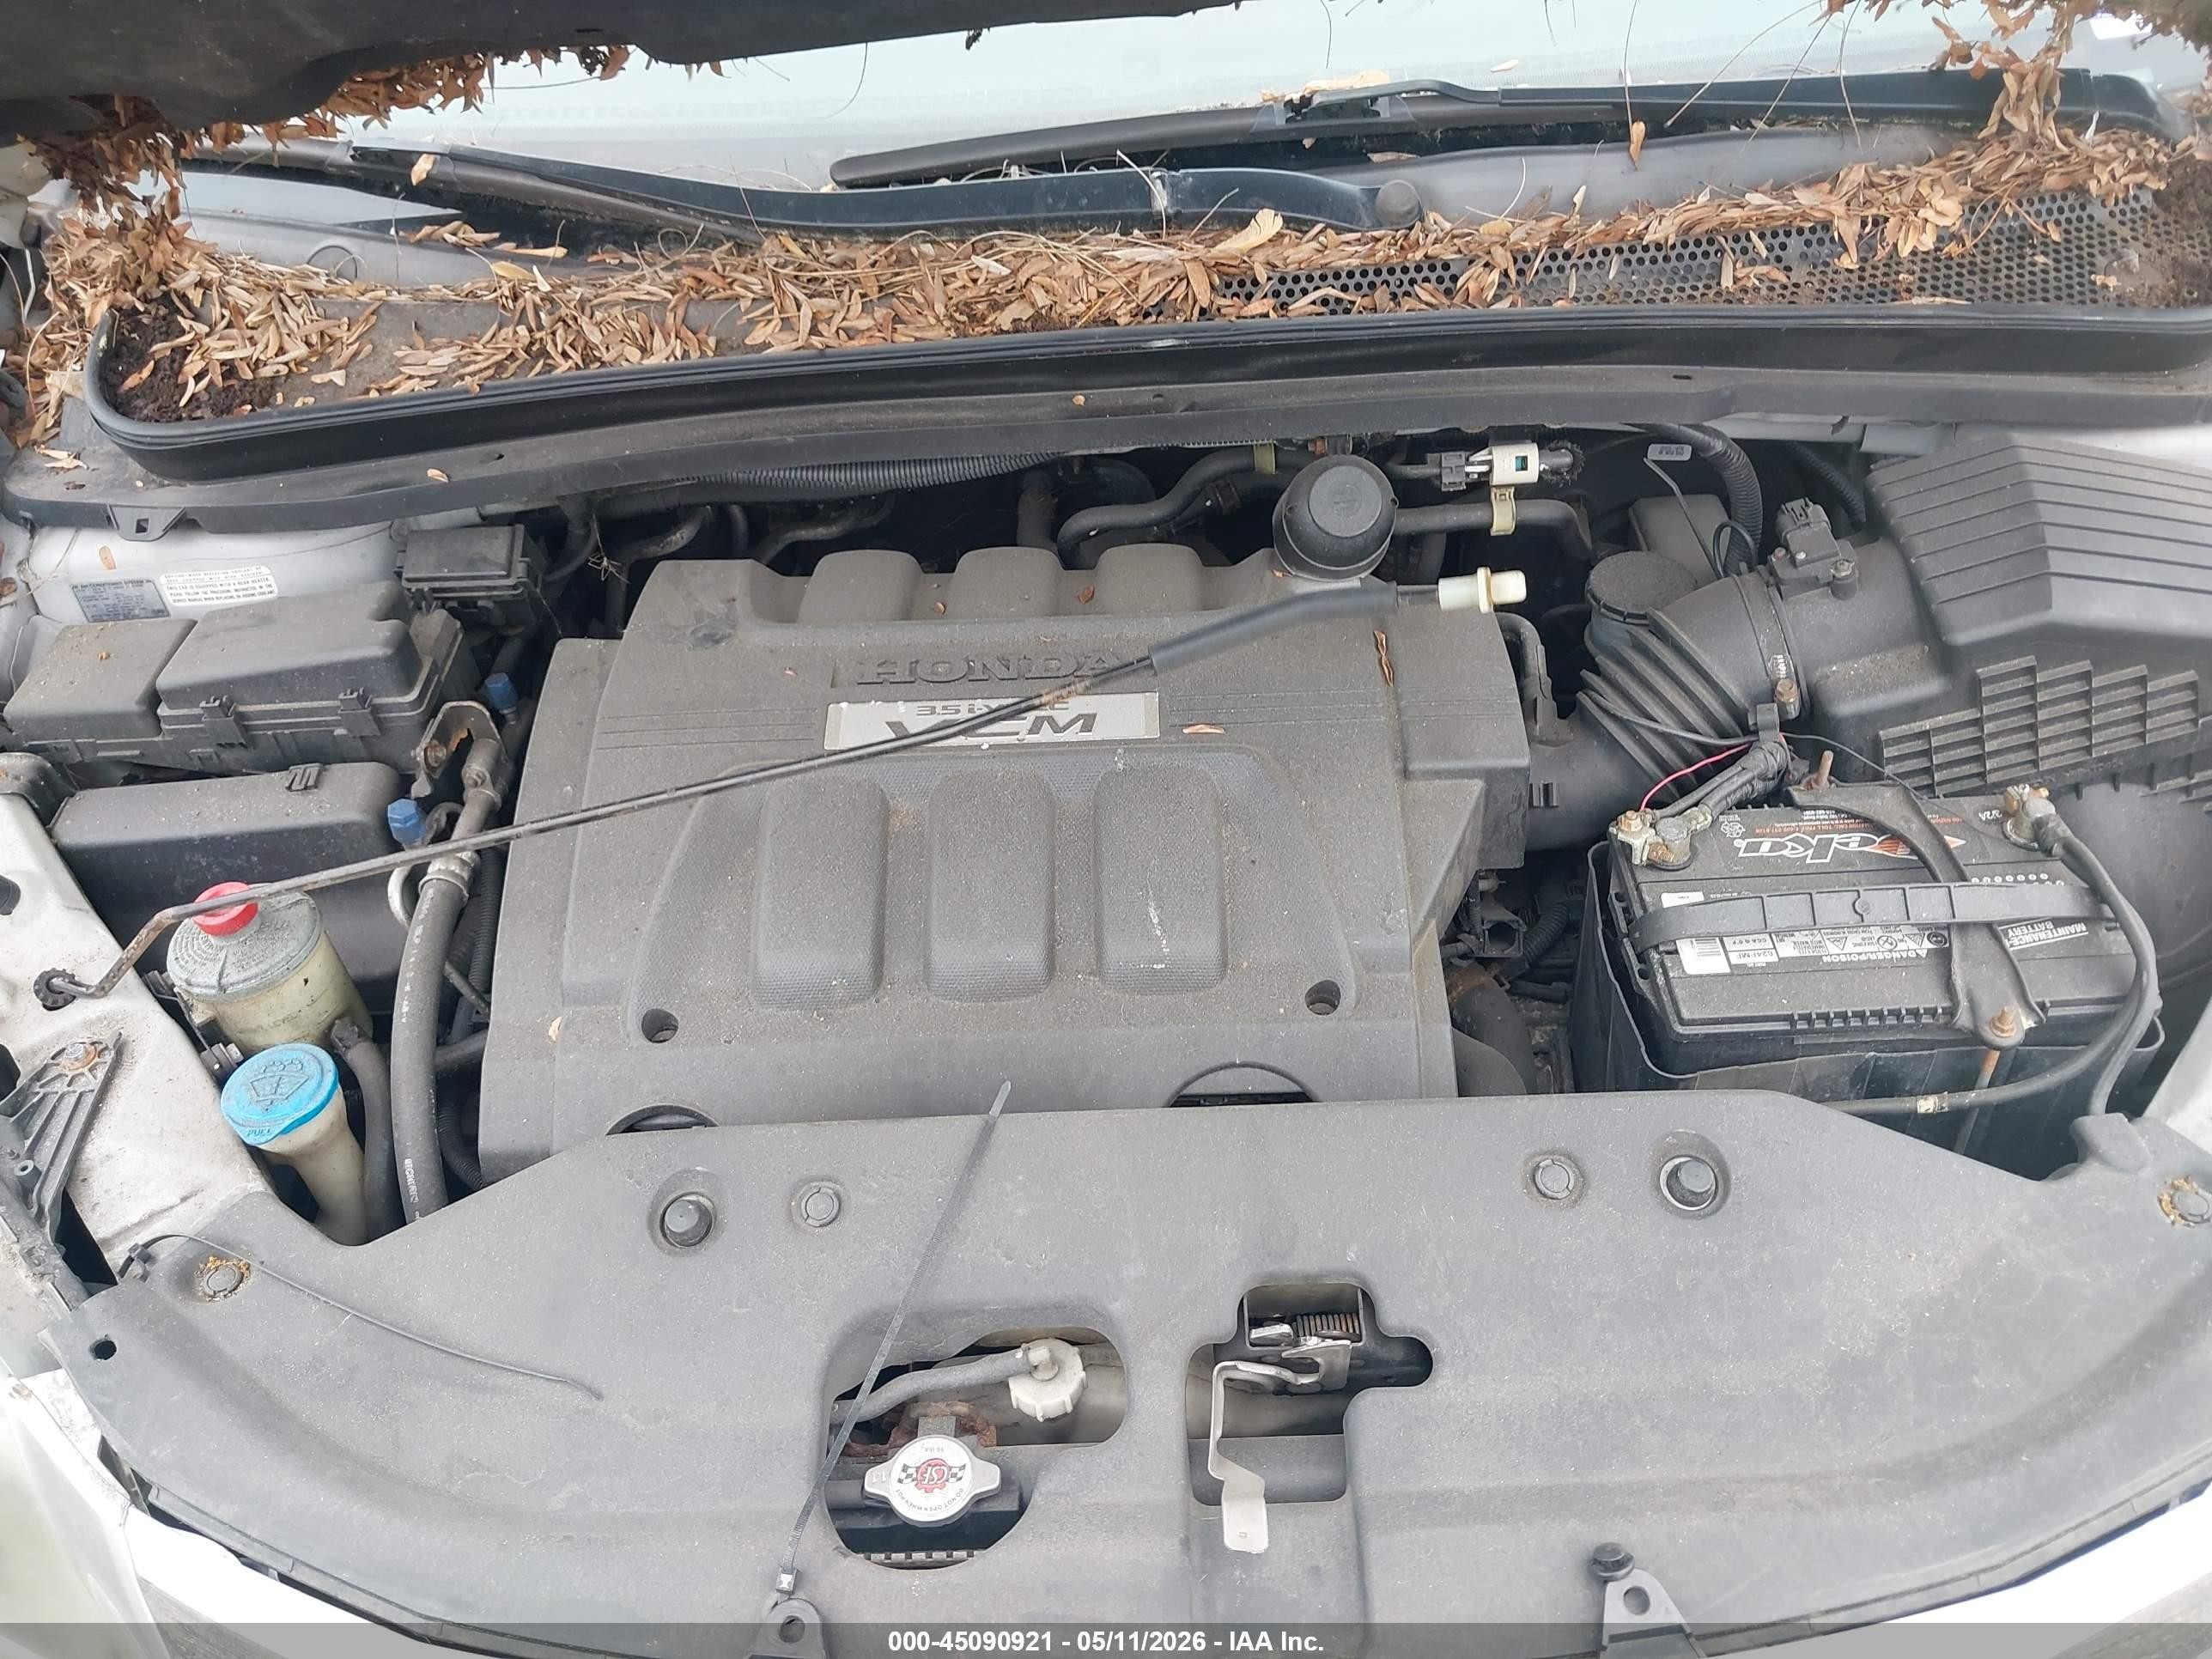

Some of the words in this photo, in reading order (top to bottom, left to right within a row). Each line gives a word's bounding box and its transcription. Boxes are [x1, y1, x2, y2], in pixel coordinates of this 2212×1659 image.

[856, 653, 1125, 685] HONDA
[916, 704, 962, 716] 3.5
[2008, 920, 2054, 939] BATTERY
[923, 1465, 946, 1485] CSF
